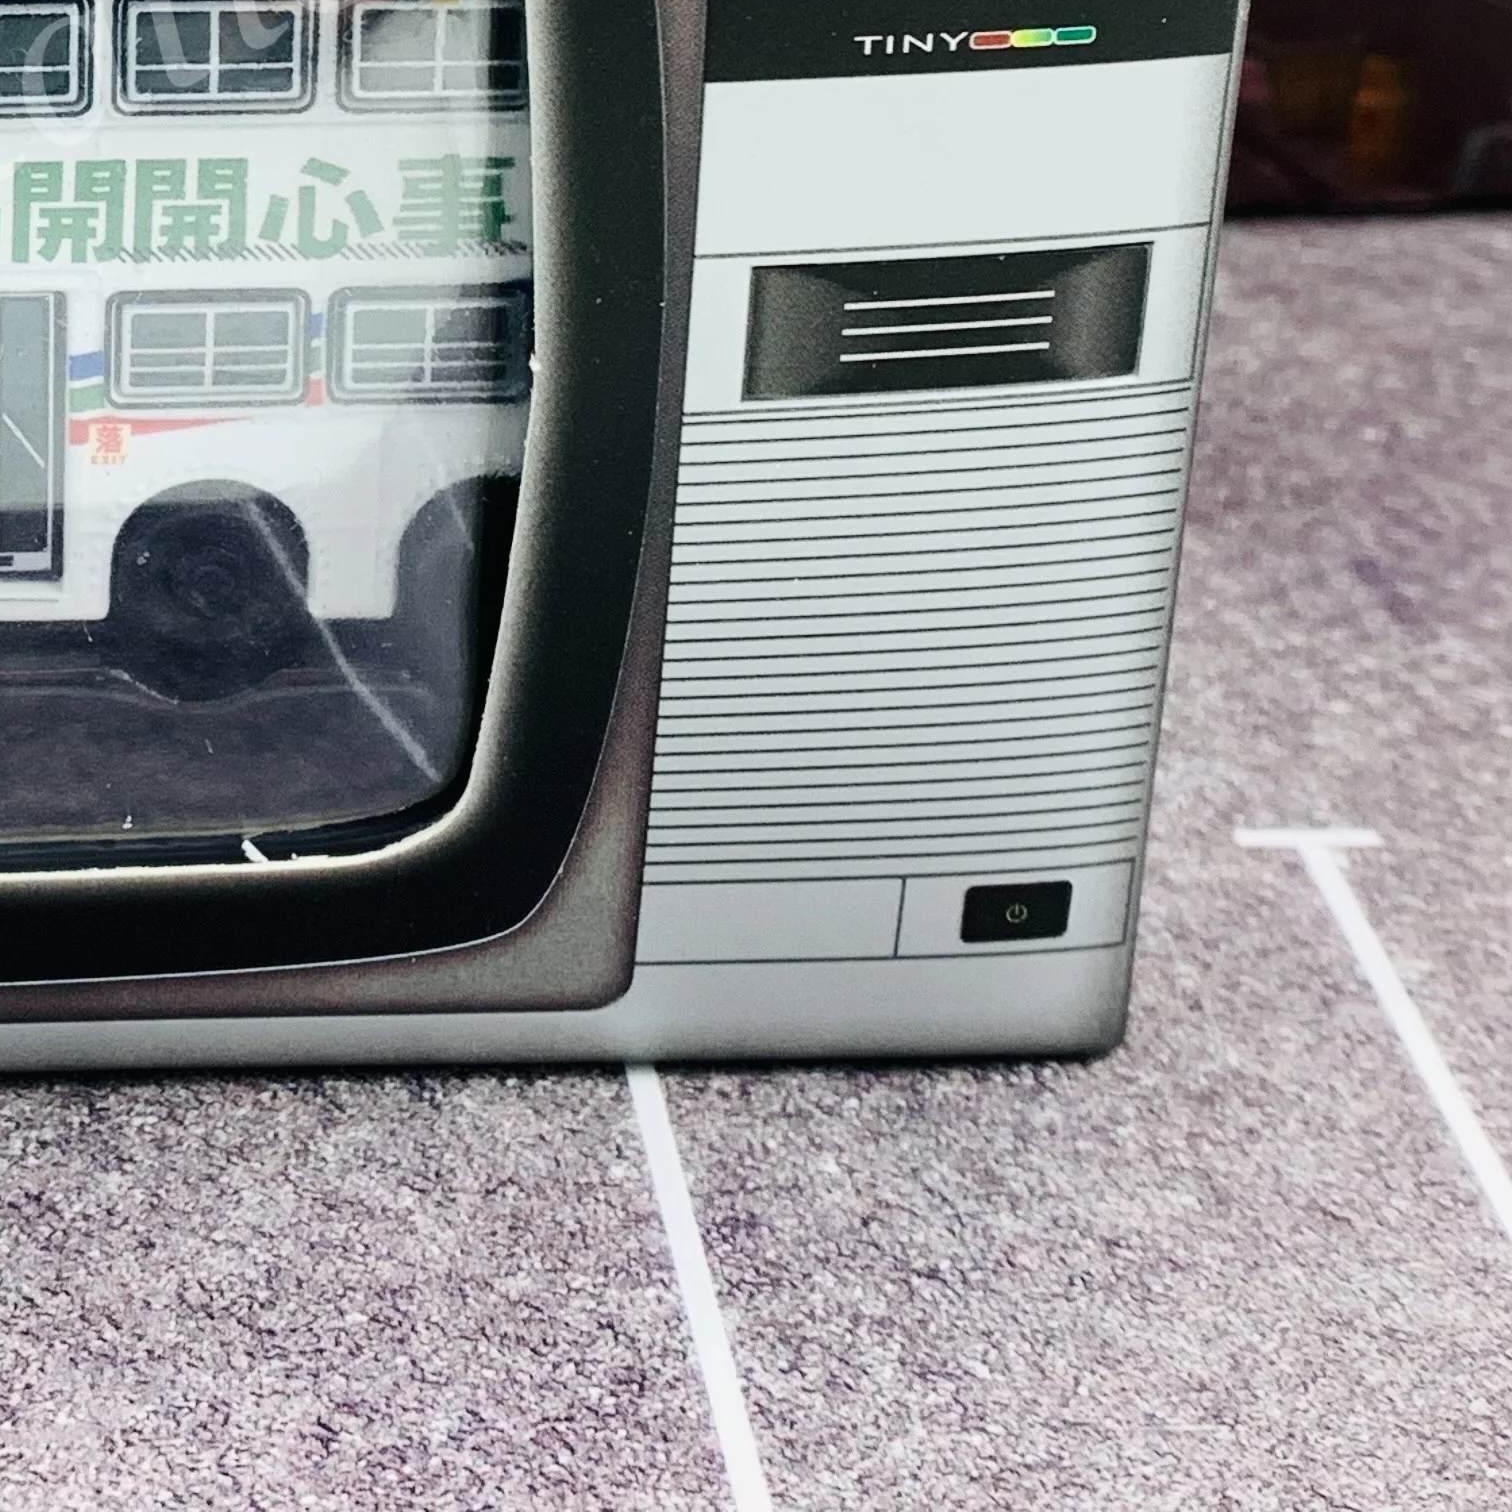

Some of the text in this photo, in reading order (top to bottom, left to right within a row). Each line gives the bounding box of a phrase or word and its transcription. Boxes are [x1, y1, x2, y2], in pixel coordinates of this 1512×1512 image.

[853, 31, 969, 56] TINY
[96, 425, 124, 453] 落
[91, 455, 127, 465] EXIT
